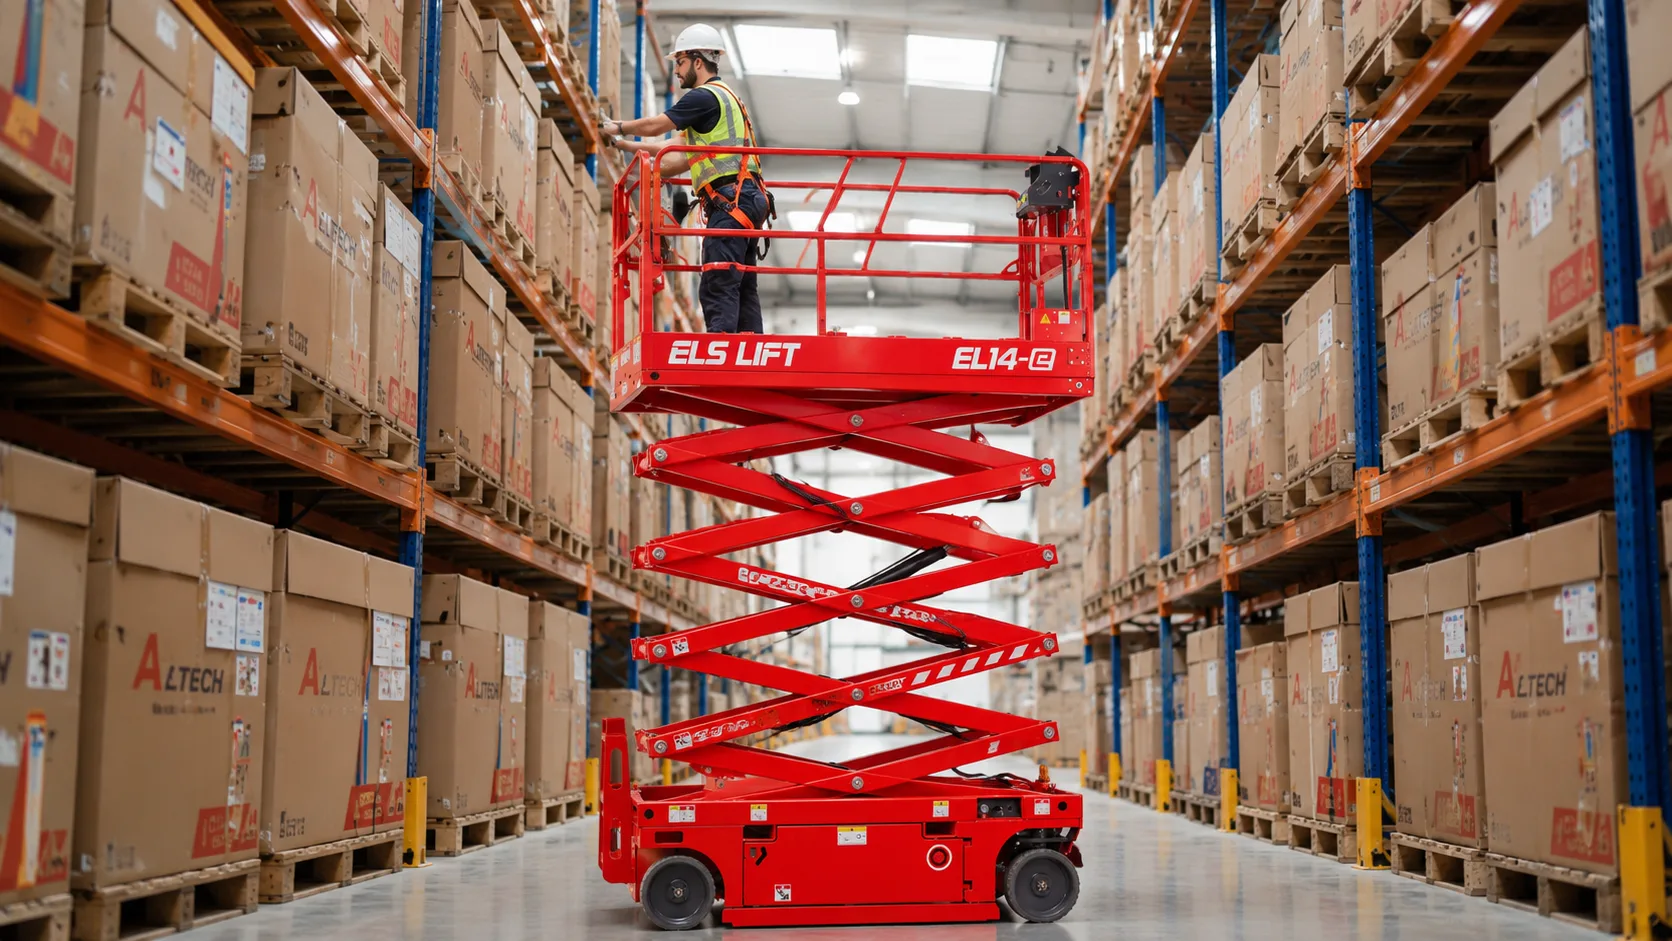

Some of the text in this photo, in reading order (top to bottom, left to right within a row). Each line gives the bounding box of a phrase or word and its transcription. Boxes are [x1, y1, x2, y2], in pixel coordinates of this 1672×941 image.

[668, 340, 801, 367] ELS LIFT
[132, 632, 224, 693] ALTECH
[1496, 650, 1566, 699] ALTECH
